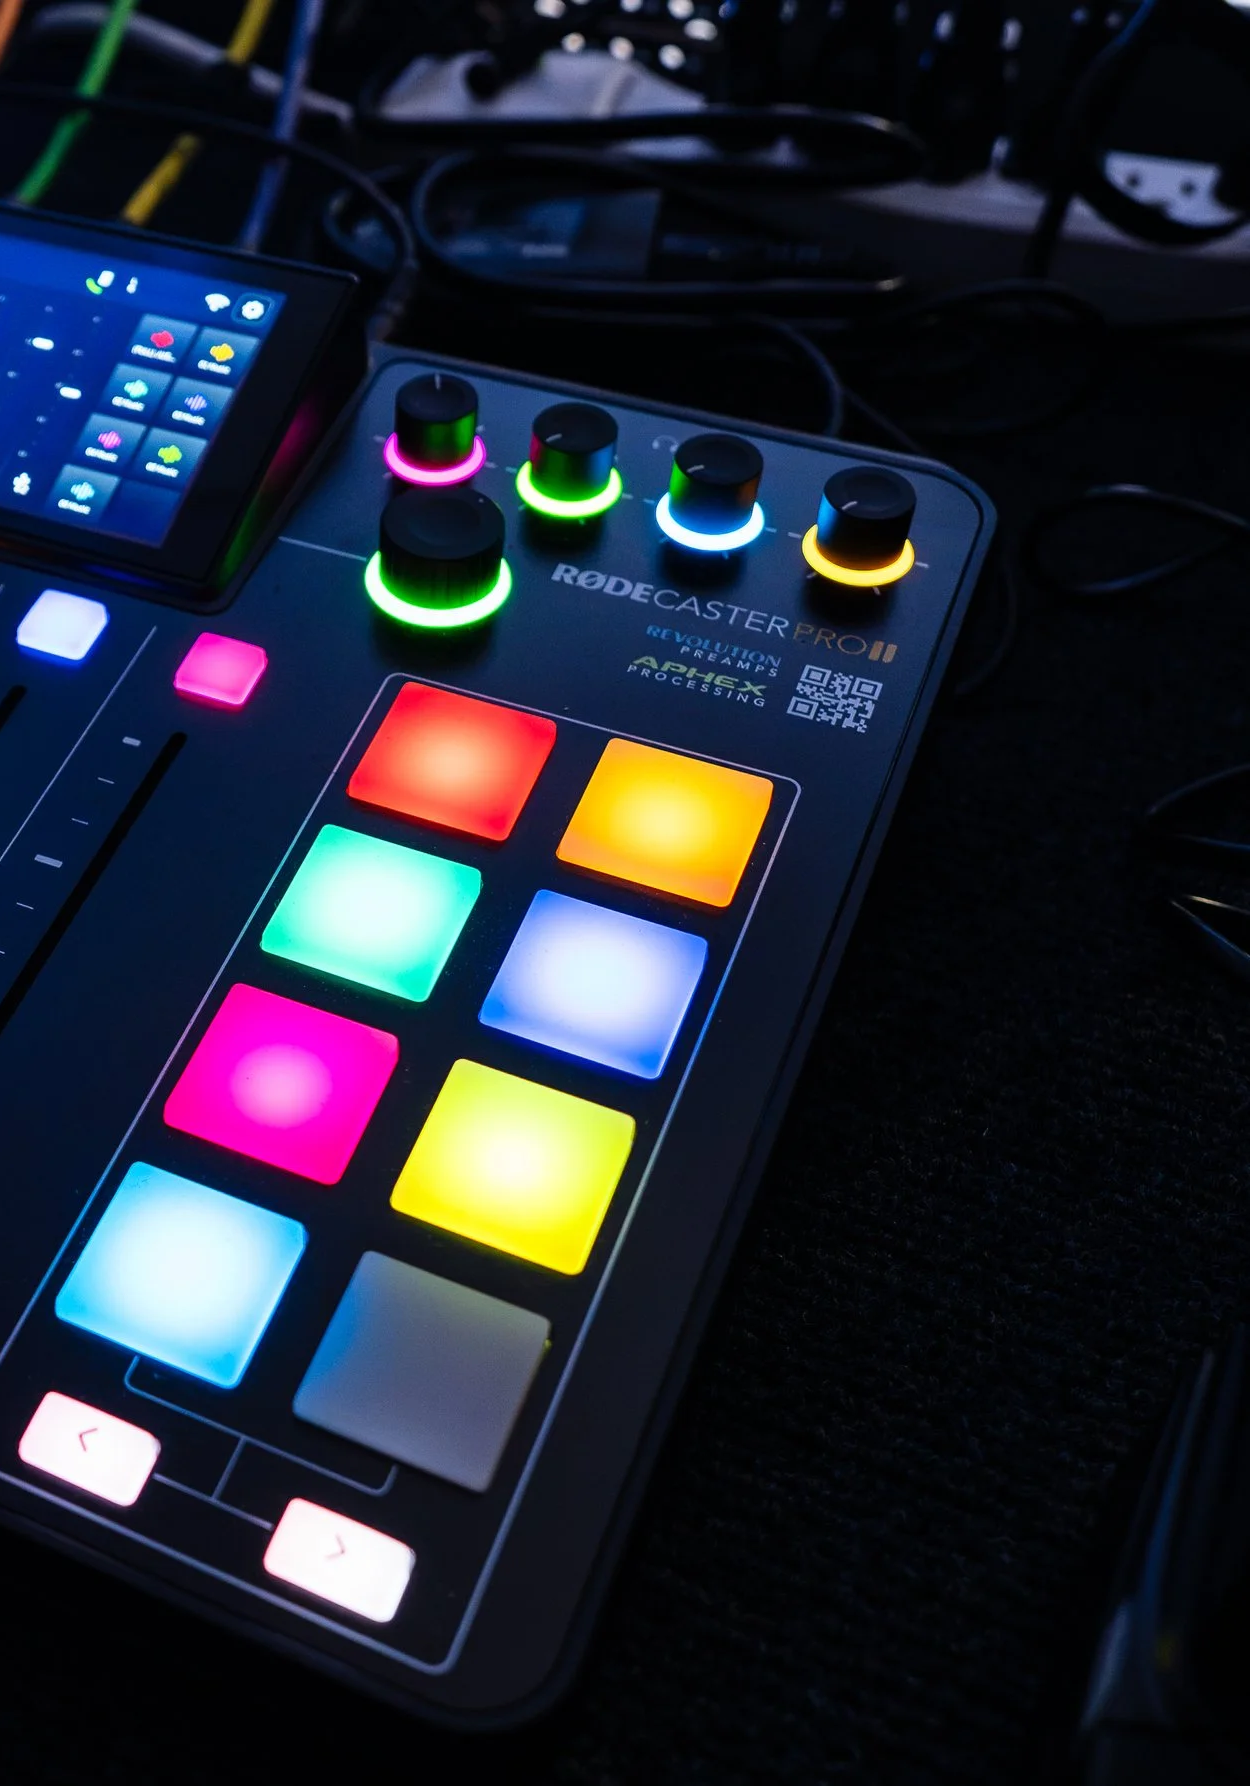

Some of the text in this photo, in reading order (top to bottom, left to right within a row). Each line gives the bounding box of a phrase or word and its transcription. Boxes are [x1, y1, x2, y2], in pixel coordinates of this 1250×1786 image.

[646, 625, 782, 668] REVOLUTION
[680, 645, 778, 678] PREAMPS
[627, 664, 766, 707] PROCESSING
[633, 655, 767, 696] APHEX
